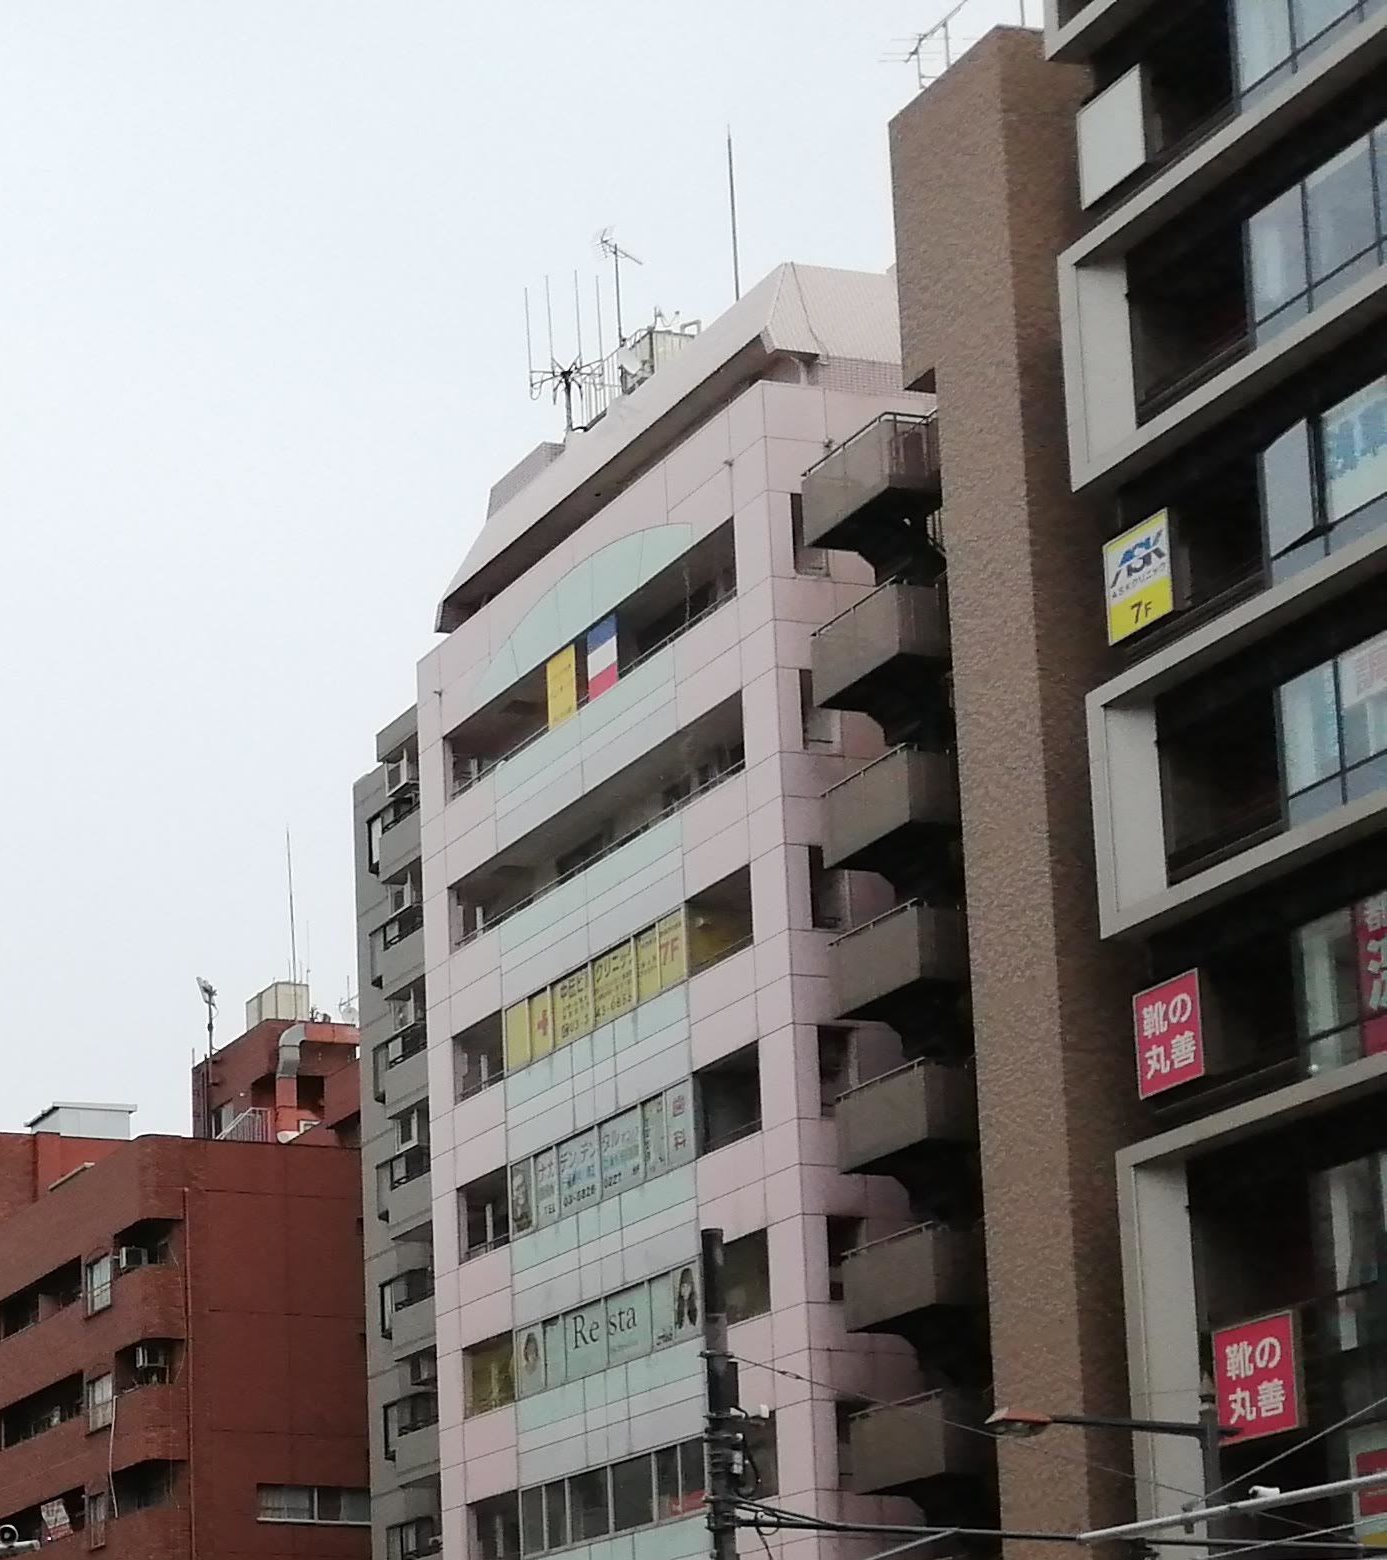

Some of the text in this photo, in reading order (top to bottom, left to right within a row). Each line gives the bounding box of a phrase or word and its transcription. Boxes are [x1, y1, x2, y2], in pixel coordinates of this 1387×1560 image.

[1131, 600, 1152, 624] 7F
[1141, 991, 1192, 1038] 靴の
[1145, 1030, 1196, 1079] 丸善
[1224, 1335, 1282, 1381] 靴の
[1228, 1377, 1288, 1425] 丸善
